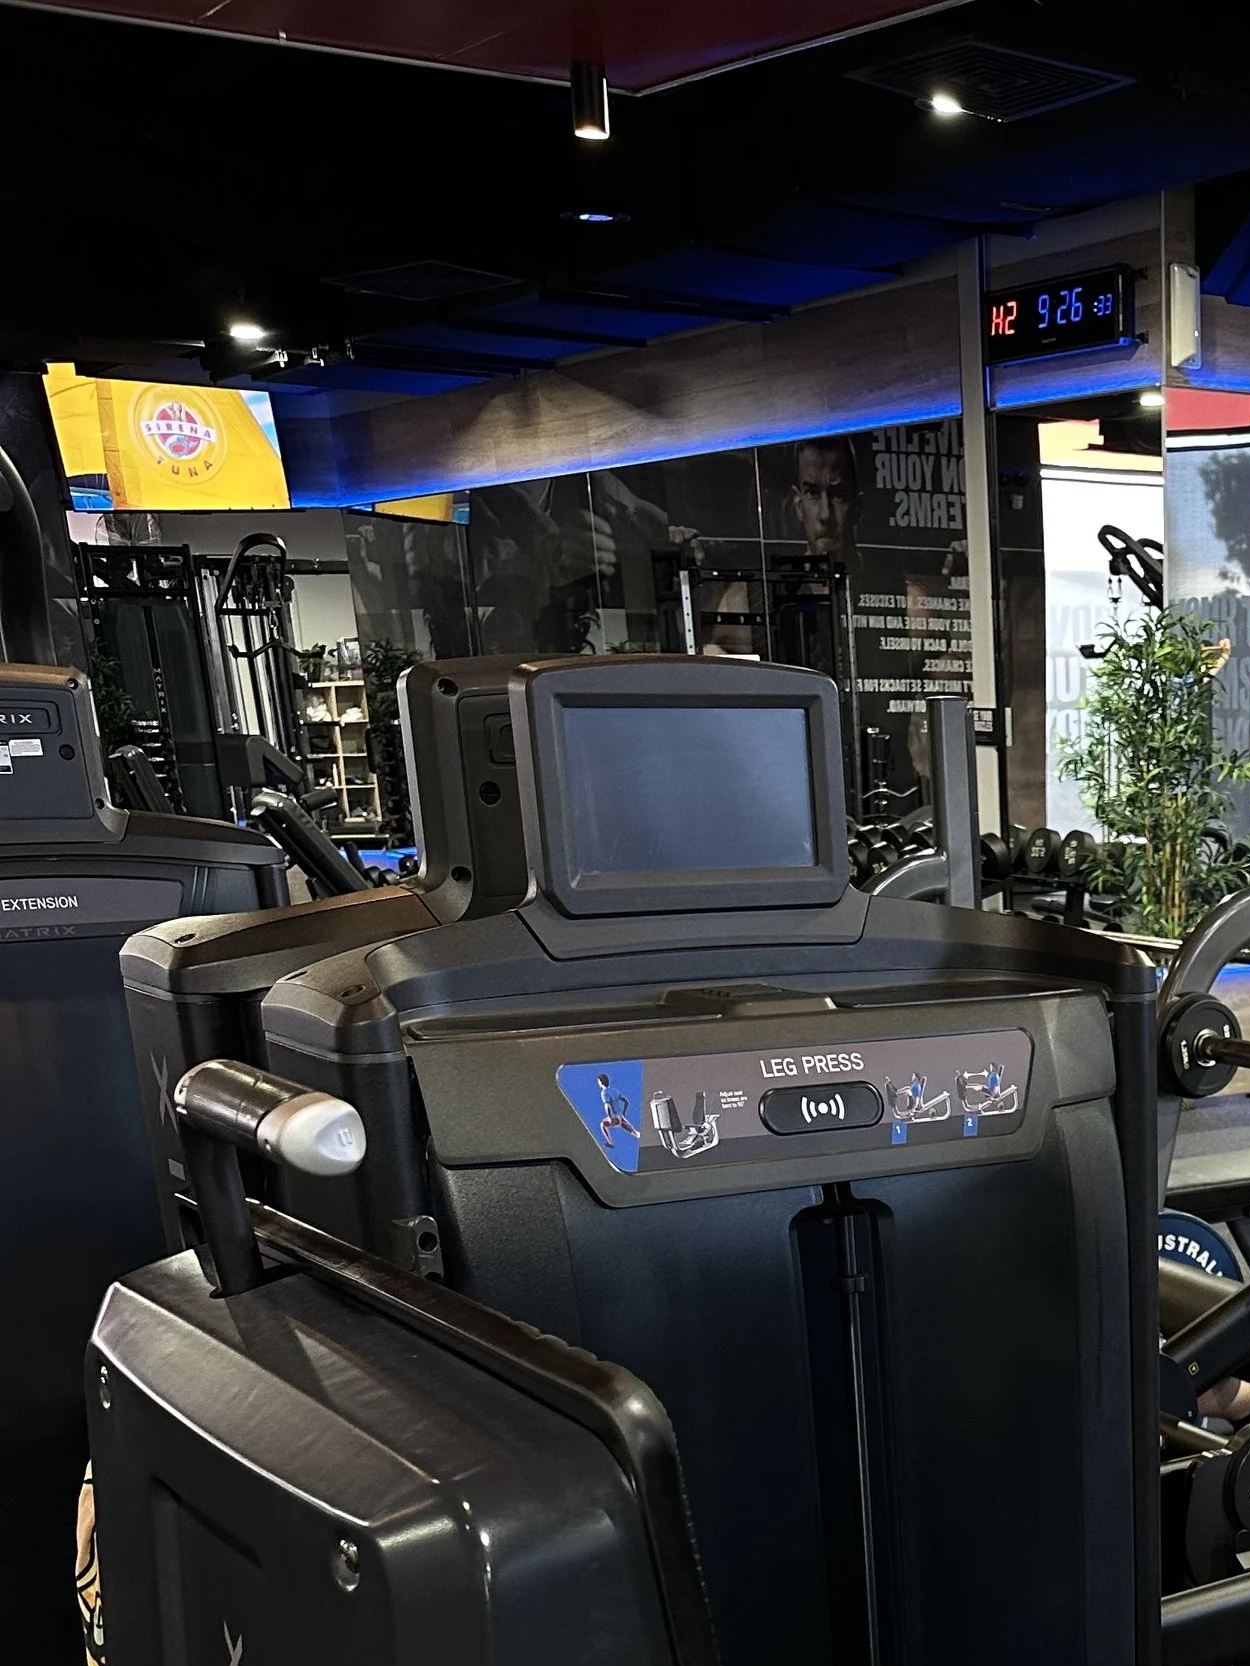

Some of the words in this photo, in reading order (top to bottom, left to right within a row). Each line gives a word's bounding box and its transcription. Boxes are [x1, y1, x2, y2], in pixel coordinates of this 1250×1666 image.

[144, 422, 213, 439] SIRENA
[157, 457, 214, 478] TUNA
[2, 895, 79, 911] EXTENSION
[760, 1057, 798, 1079] LEG
[801, 1052, 865, 1075] PRESS
